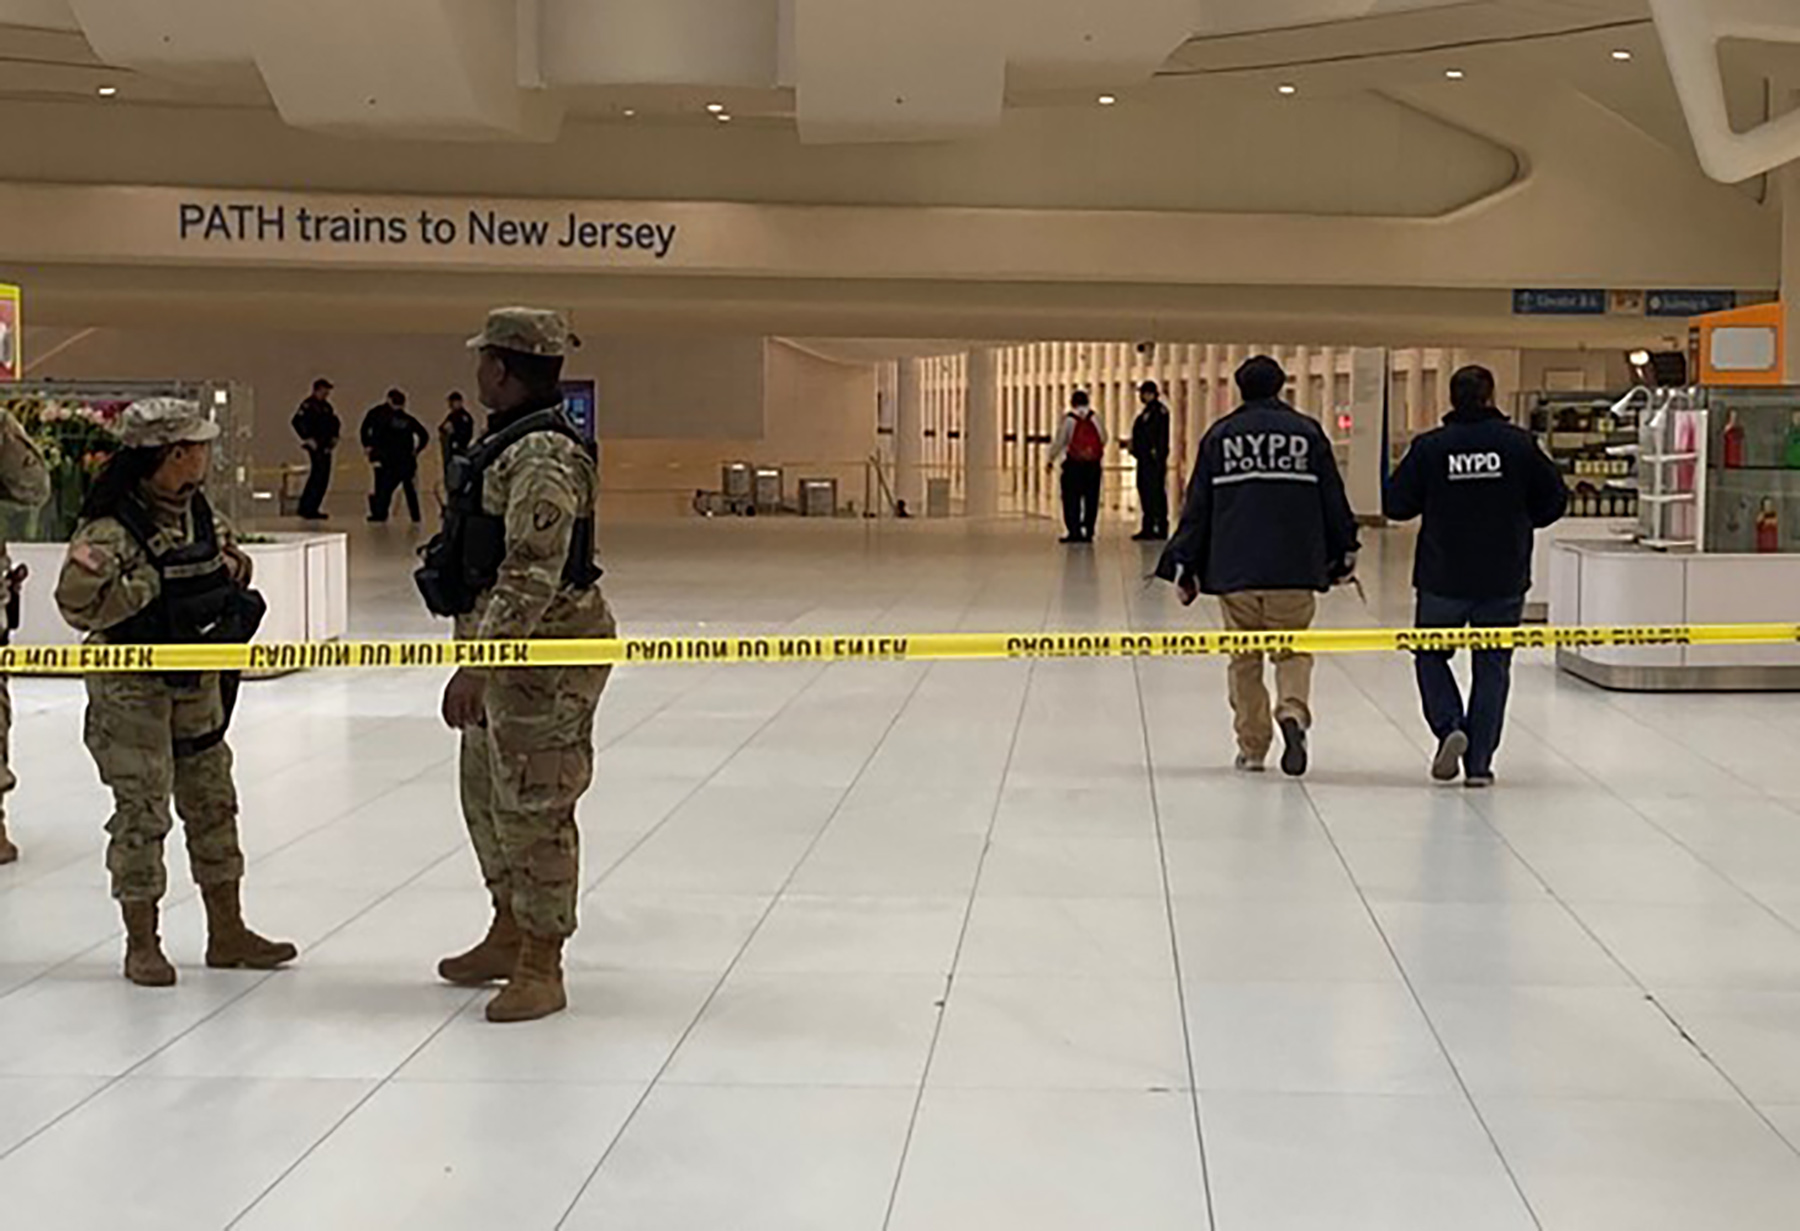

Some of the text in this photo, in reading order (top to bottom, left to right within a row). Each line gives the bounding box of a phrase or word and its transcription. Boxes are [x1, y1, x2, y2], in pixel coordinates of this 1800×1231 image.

[180, 203, 676, 258] PATH trains to New Jersey
[1222, 433, 1309, 459] NYPD
[1224, 455, 1308, 473] POLICE
[1448, 452, 1501, 473] NYPD
